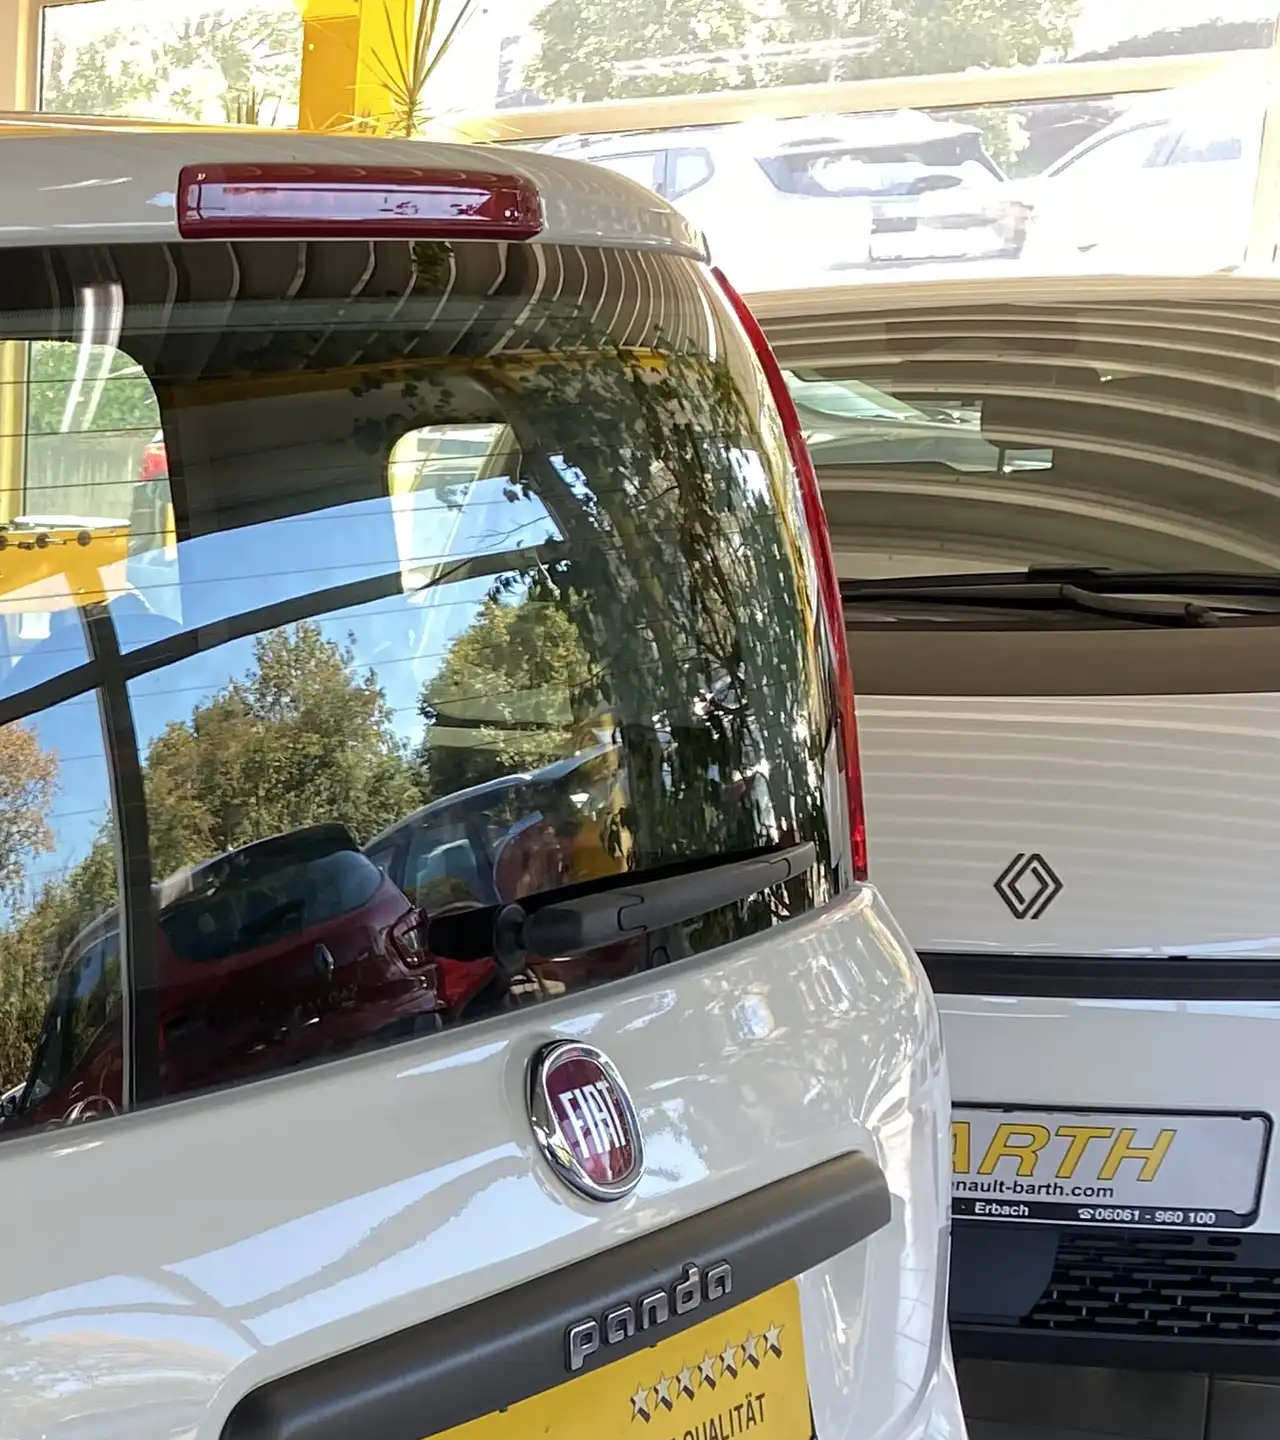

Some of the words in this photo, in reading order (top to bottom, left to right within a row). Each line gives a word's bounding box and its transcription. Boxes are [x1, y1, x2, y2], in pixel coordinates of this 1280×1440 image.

[558, 1079, 626, 1159] FIAT
[951, 1179, 1113, 1198] nault-barth.com
[974, 1202, 1029, 1216] Erbach
[1095, 1208, 1140, 1221] 06061
[1155, 1210, 1184, 1223] 960
[1188, 1212, 1216, 1225] 100
[566, 1260, 734, 1372] panda
